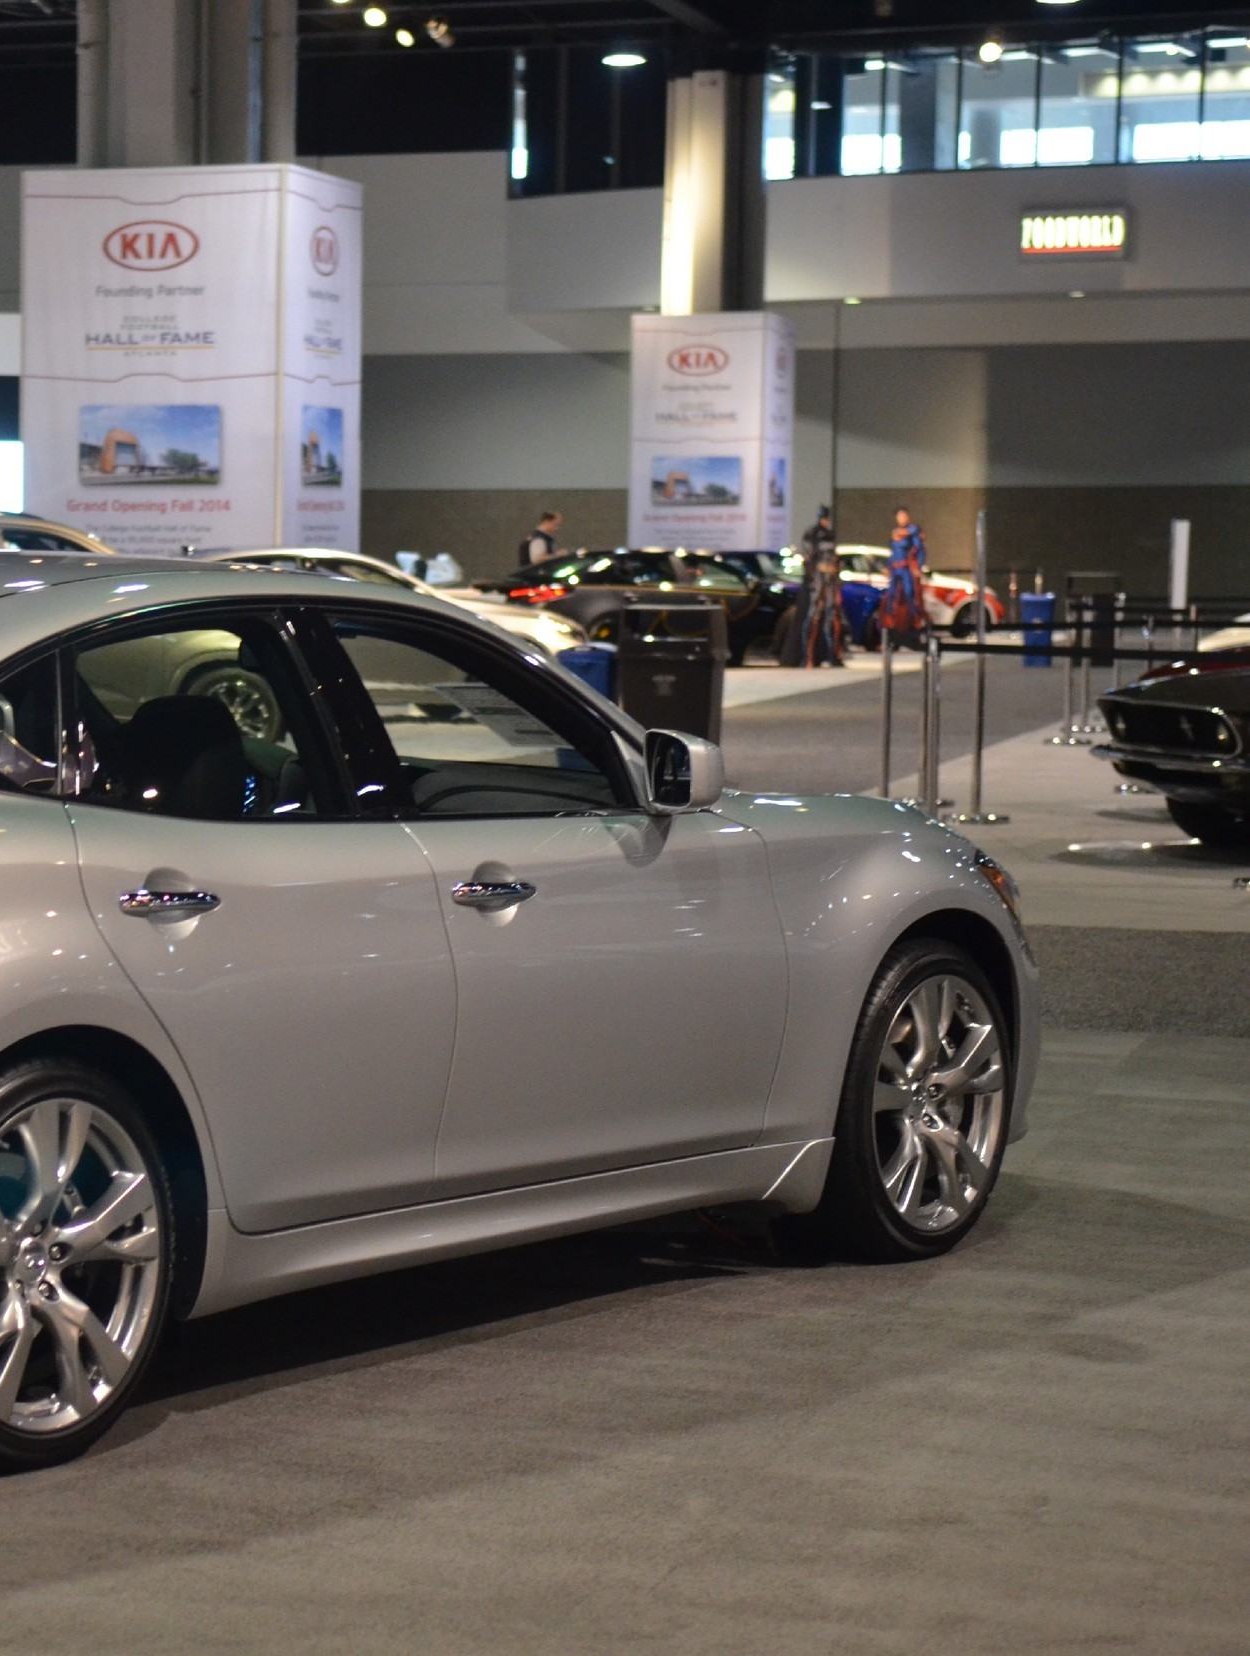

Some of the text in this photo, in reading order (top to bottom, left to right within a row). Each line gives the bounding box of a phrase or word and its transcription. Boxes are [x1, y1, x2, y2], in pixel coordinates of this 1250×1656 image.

[1021, 214, 1125, 249] FOODWORLD
[120, 232, 182, 260] KIA
[95, 285, 205, 299] Founding Partner
[85, 332, 139, 345] HALL
[160, 331, 216, 345] FAME
[678, 352, 718, 369] KIA
[66, 498, 231, 514] Grand Opening Fall 2014
